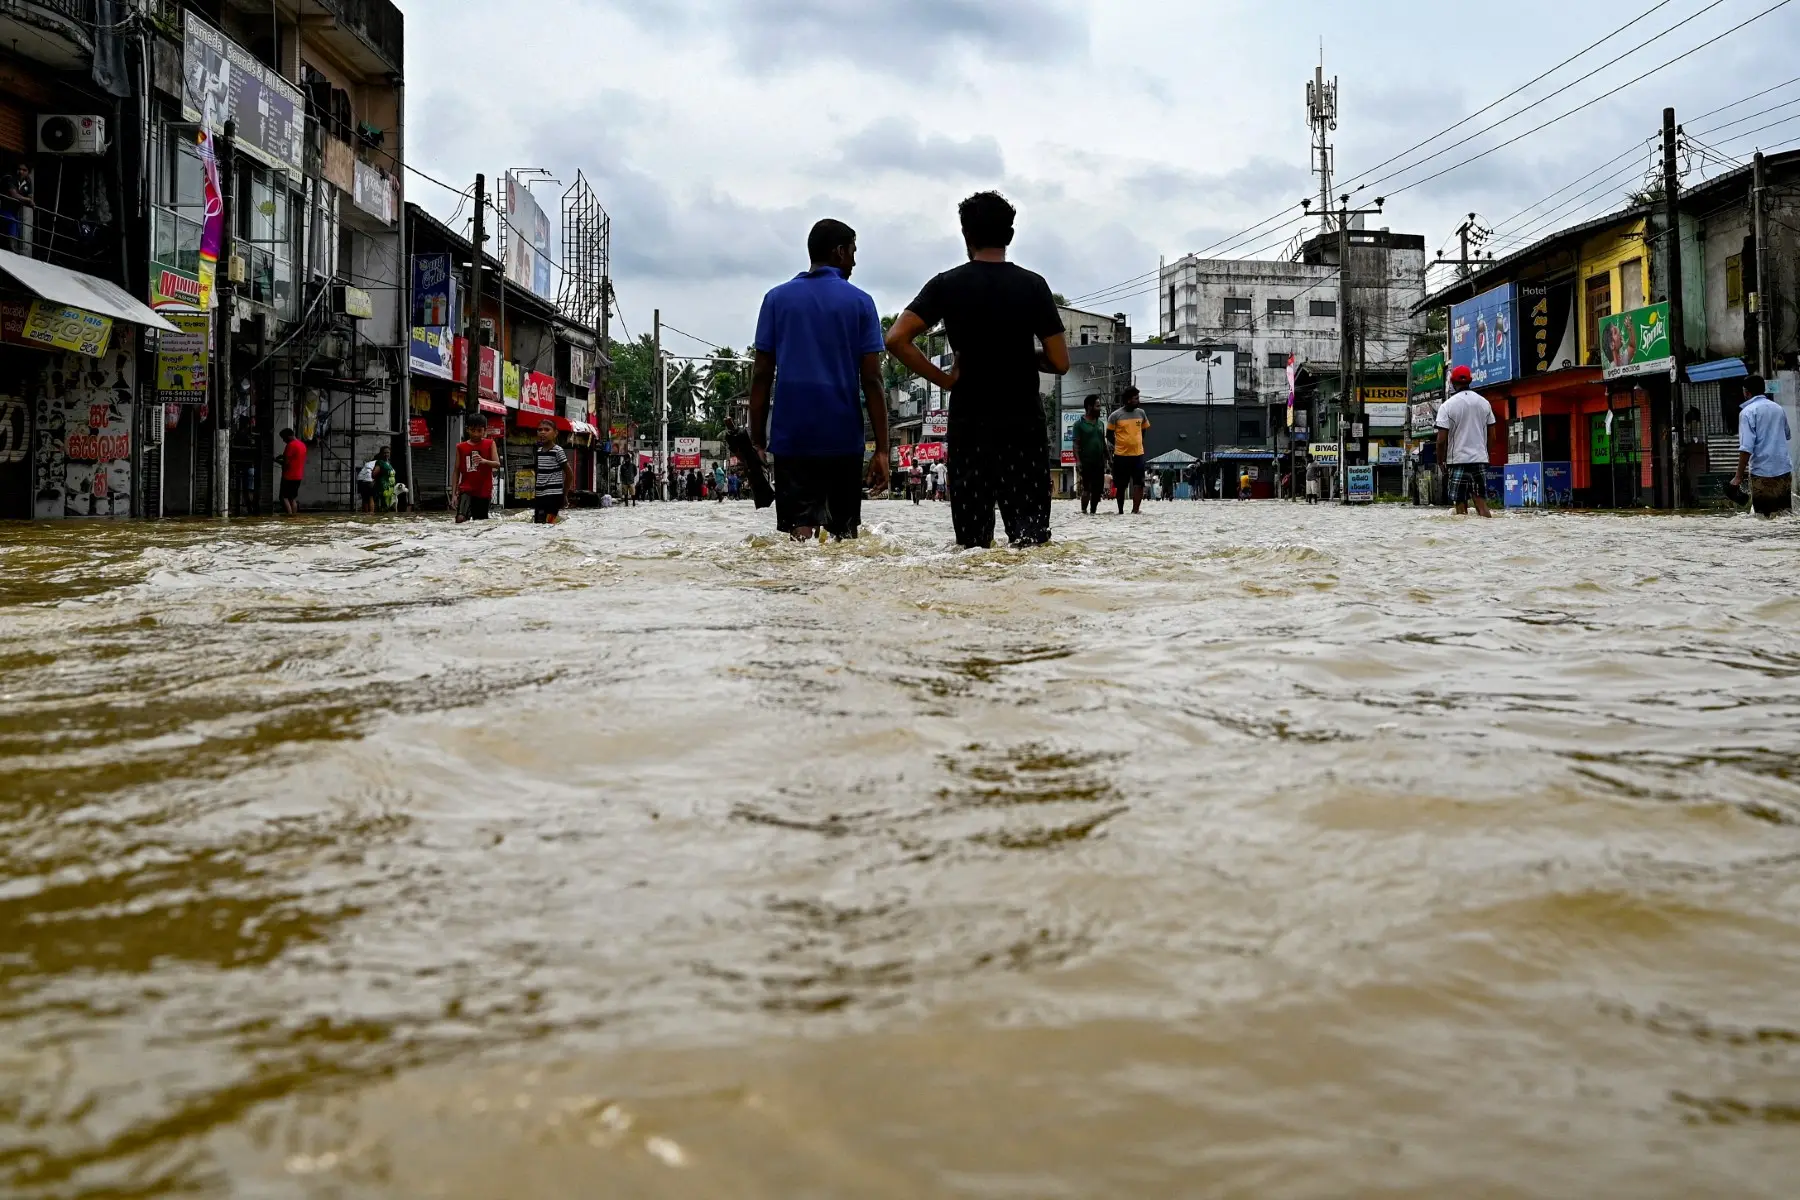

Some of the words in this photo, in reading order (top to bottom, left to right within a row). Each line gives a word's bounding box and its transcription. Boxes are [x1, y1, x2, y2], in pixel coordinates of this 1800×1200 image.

[188, 14, 224, 54] Sumeda
[226, 42, 257, 78] Sounds
[265, 70, 277, 93] All
[175, 291, 199, 304] FASHION
[1522, 286, 1547, 295] Hotel
[61, 310, 81, 320] 350
[82, 315, 103, 327] 1416
[1642, 321, 1663, 350] Sprite
